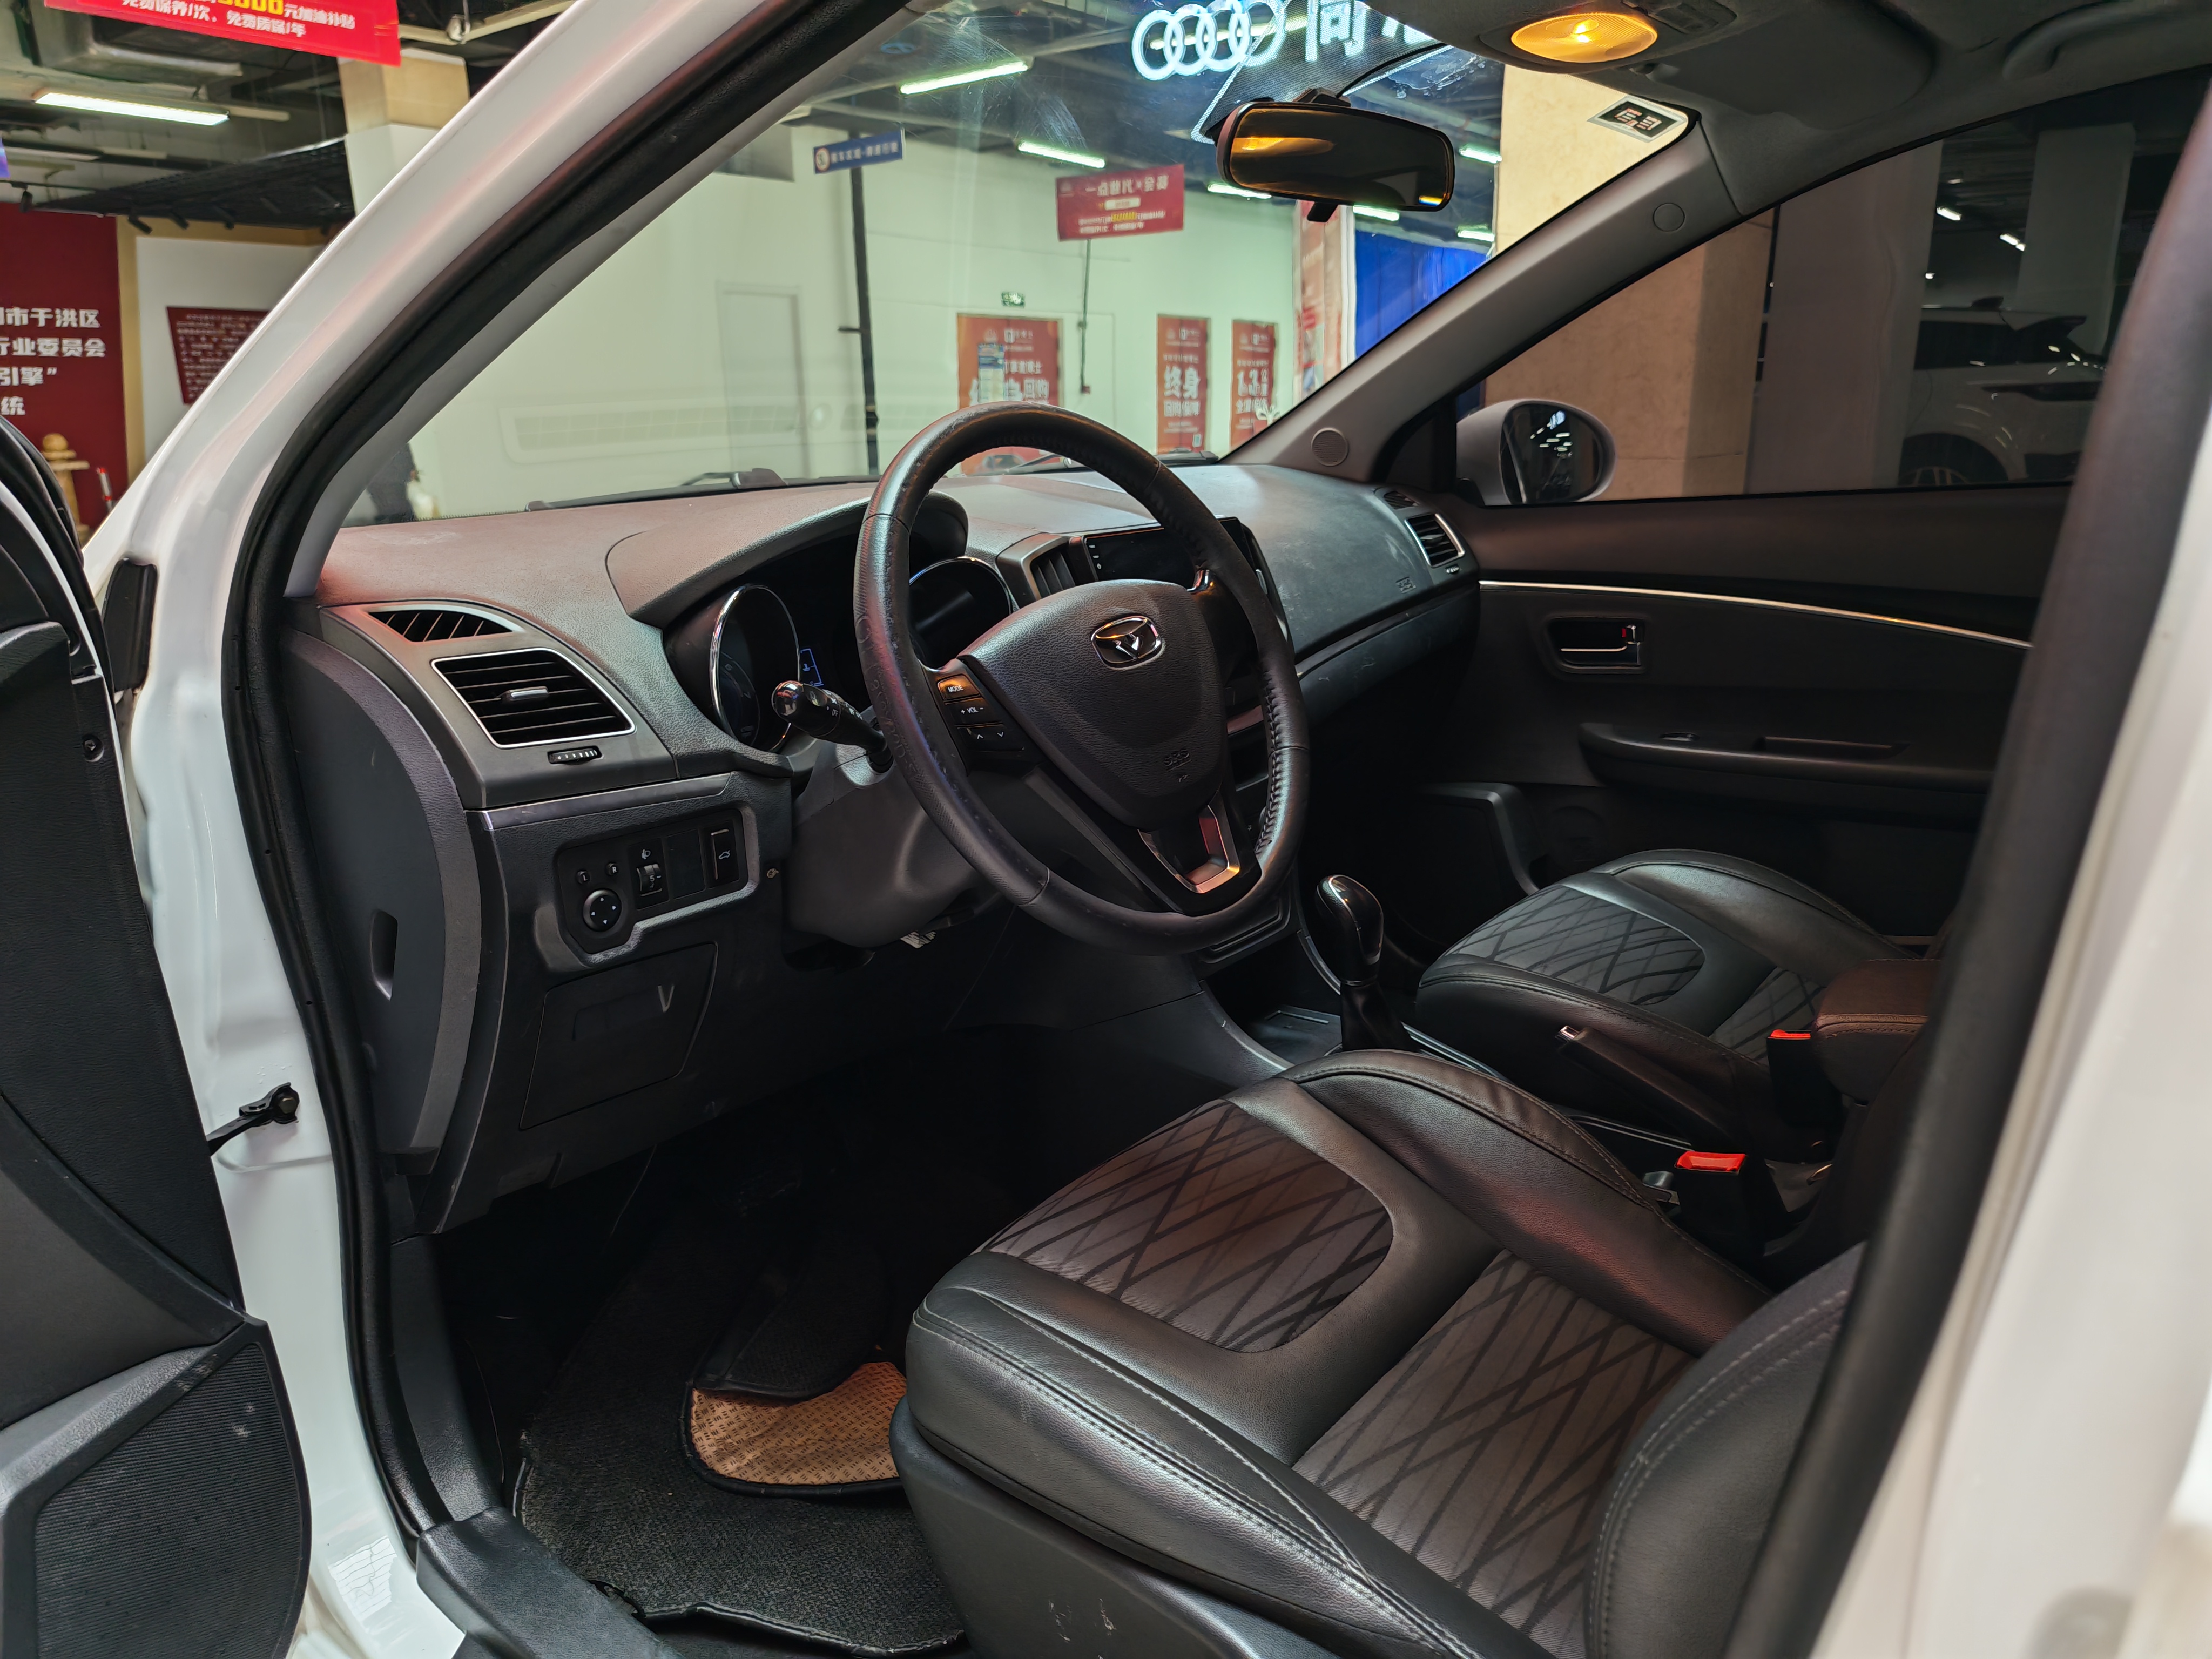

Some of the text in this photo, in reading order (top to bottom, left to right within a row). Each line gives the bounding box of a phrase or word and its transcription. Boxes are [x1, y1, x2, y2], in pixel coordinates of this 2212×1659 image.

[0, 306, 102, 328] 市于洪区
[947, 685, 964, 693] MODE
